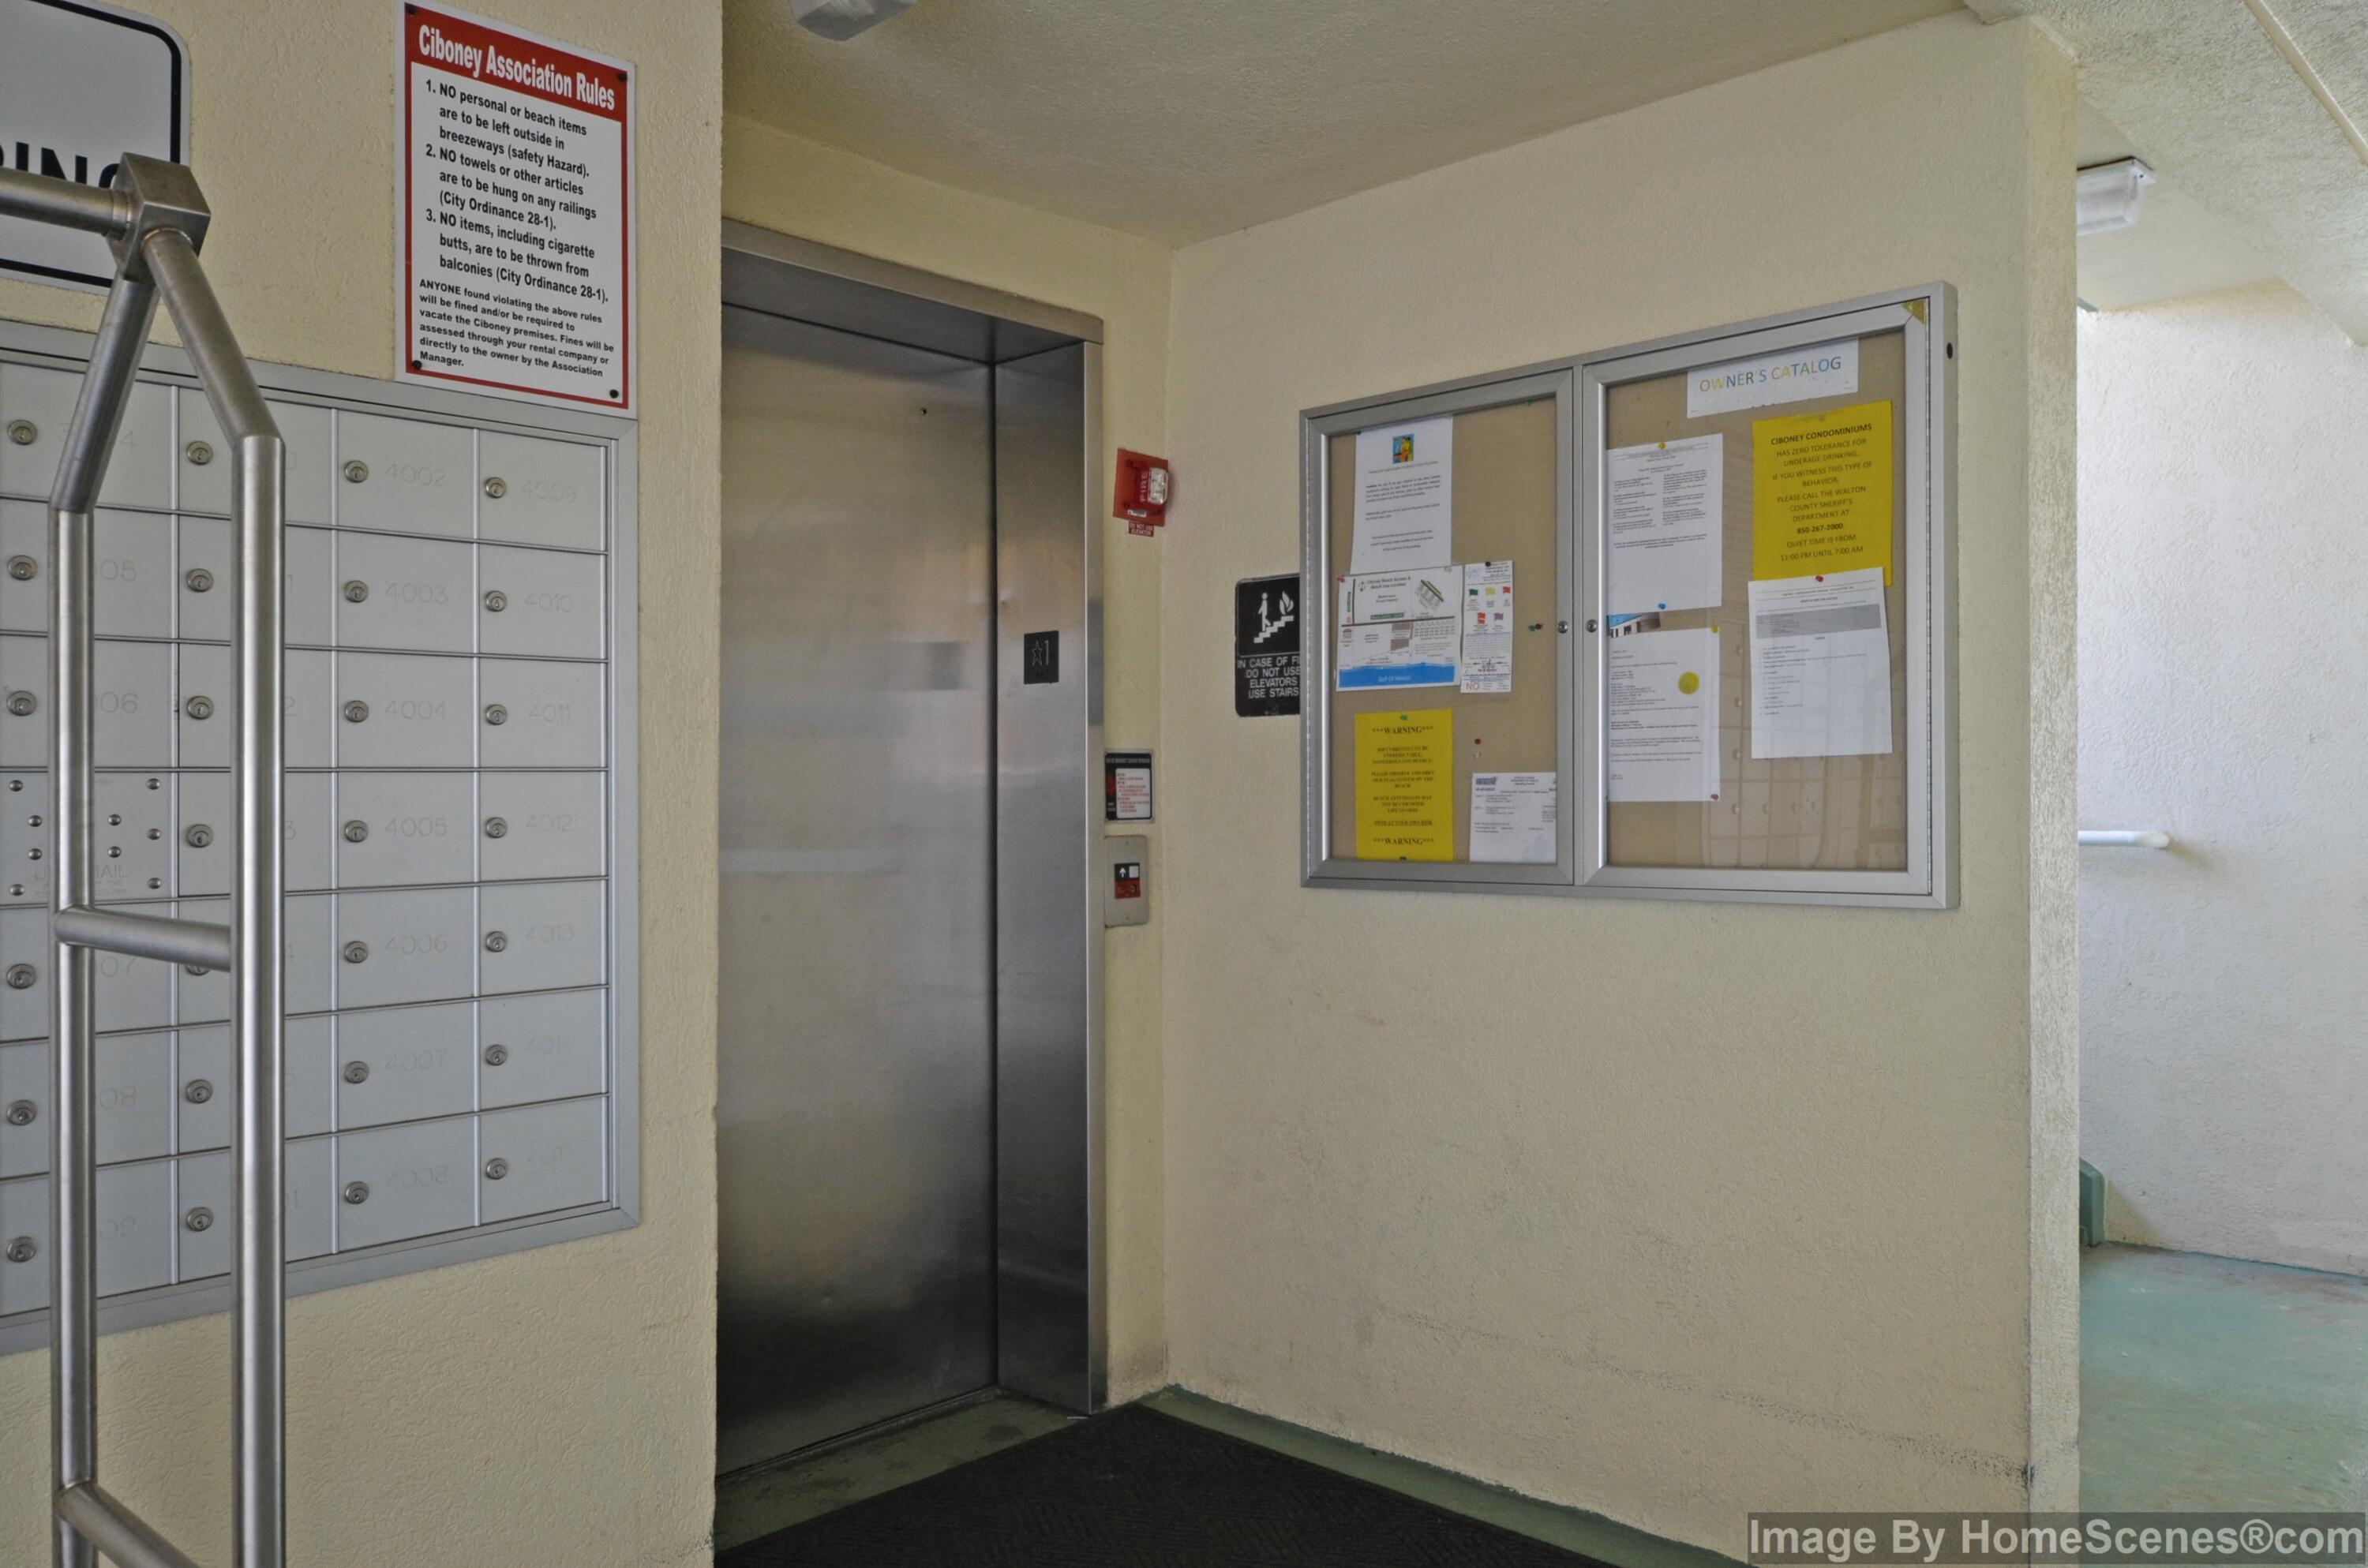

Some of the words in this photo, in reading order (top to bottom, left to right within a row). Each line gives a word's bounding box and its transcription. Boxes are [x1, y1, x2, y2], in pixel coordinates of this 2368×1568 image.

[418, 24, 482, 78] Ciboney
[485, 44, 571, 98] Association
[575, 71, 615, 110] Rules
[425, 78, 436, 93] 1.
[439, 82, 456, 99] NO
[459, 91, 507, 113] personal
[509, 106, 521, 117] or
[523, 107, 556, 126] beach
[558, 116, 586, 136] items
[439, 107, 458, 121] are
[460, 110, 472, 125] to
[475, 113, 489, 129] be
[492, 118, 510, 135] left
[512, 127, 552, 146] outside
[555, 135, 564, 150] in
[439, 125, 504, 155] breezeways
[507, 144, 544, 167] (safety
[546, 154, 589, 178] Hazard).
[425, 143, 436, 158] 2.
[439, 146, 456, 163] NO
[459, 152, 496, 173] towels
[499, 165, 511, 177] or
[513, 168, 541, 185] other
[544, 177, 583, 195] articles
[439, 171, 458, 185] are
[460, 174, 472, 188] to
[475, 177, 489, 193] be
[492, 181, 518, 203] hung
[521, 192, 534, 204] on
[537, 196, 556, 211] any
[558, 200, 597, 220] railings
[439, 189, 466, 211] (City
[468, 196, 524, 222] Ordinance
[526, 211, 556, 232] 28-1).
[425, 208, 436, 223] 3.
[439, 211, 456, 226] NO
[459, 215, 493, 238] items,
[496, 224, 545, 250] including
[547, 238, 594, 258] cigarette
[439, 232, 471, 255] butts,
[474, 243, 493, 256] are
[495, 245, 507, 260] to
[510, 248, 523, 263] be
[526, 253, 562, 271] thrown
[564, 260, 589, 278] from
[439, 253, 493, 278] balconies
[496, 266, 521, 286] (City
[523, 272, 577, 295] Ordinance
[579, 284, 608, 304] 28-1).
[418, 278, 461, 295] ANYONE
[463, 286, 490, 301] found
[492, 294, 532, 311] violating
[534, 302, 549, 312] the
[551, 305, 578, 318] above
[579, 312, 602, 323] rules
[418, 294, 437, 305] will
[439, 296, 451, 307] be
[453, 299, 478, 312] fined
[480, 306, 510, 319] and/or
[511, 311, 523, 321] be
[526, 316, 564, 329] required
[565, 322, 575, 331] to
[419, 309, 452, 322] vacate
[455, 314, 470, 325] the
[473, 317, 511, 335] Ciboney
[513, 327, 557, 342] premises.
[560, 334, 583, 346] Fines
[585, 340, 601, 350] will
[603, 342, 614, 352] be
[419, 323, 465, 338] assessed
[466, 331, 504, 346] through
[506, 339, 526, 350] your
[529, 343, 556, 355] rental
[557, 349, 598, 364] company
[419, 336, 457, 353] directly
[459, 343, 470, 354] to
[471, 346, 488, 357] the
[489, 350, 519, 361] owner
[520, 354, 532, 366] by
[534, 357, 549, 368] the
[551, 359, 602, 376] Association
[419, 350, 464, 366] Manager.
[1699, 369, 1767, 392] OWNER'S
[1771, 357, 1842, 380] CATALOG
[1770, 434, 1804, 445] CIBONEY
[1805, 422, 1872, 440] CONDOMINIUMS
[1775, 448, 1790, 457] HAS
[1791, 446, 1809, 455] ZERO
[1810, 440, 1850, 451] TOLERANCE
[1851, 437, 1867, 446] FOR
[384, 463, 447, 487] 4002
[1795, 466, 1827, 477] WITNESS
[1827, 464, 1843, 473] THIS
[1844, 462, 1860, 470] TYPE
[1776, 493, 1800, 503] PLEASE
[1834, 485, 1867, 496] WALTON
[1789, 502, 1818, 512] COUNTY
[1792, 510, 1838, 522] DEPARTMENT
[1785, 538, 1807, 548] QUIET
[1808, 537, 1826, 545] TIME
[1834, 533, 1857, 543] FROM
[1812, 548, 1833, 558] UNTIL
[1850, 544, 1864, 553] AM
[385, 582, 448, 604] 4003
[1237, 660, 1246, 668] IN
[1250, 657, 1272, 668] CASE
[1276, 656, 1288, 666] OF
[1246, 669, 1259, 678] DO
[1262, 668, 1280, 677] NOT
[1283, 666, 1300, 676] USE
[1249, 689, 1265, 698] USE
[1269, 687, 1299, 698] STAIRS
[1250, 677, 1298, 688] ELEVATORS
[384, 700, 449, 720] 4004
[384, 817, 448, 838] 4005
[384, 934, 448, 955] 4006
